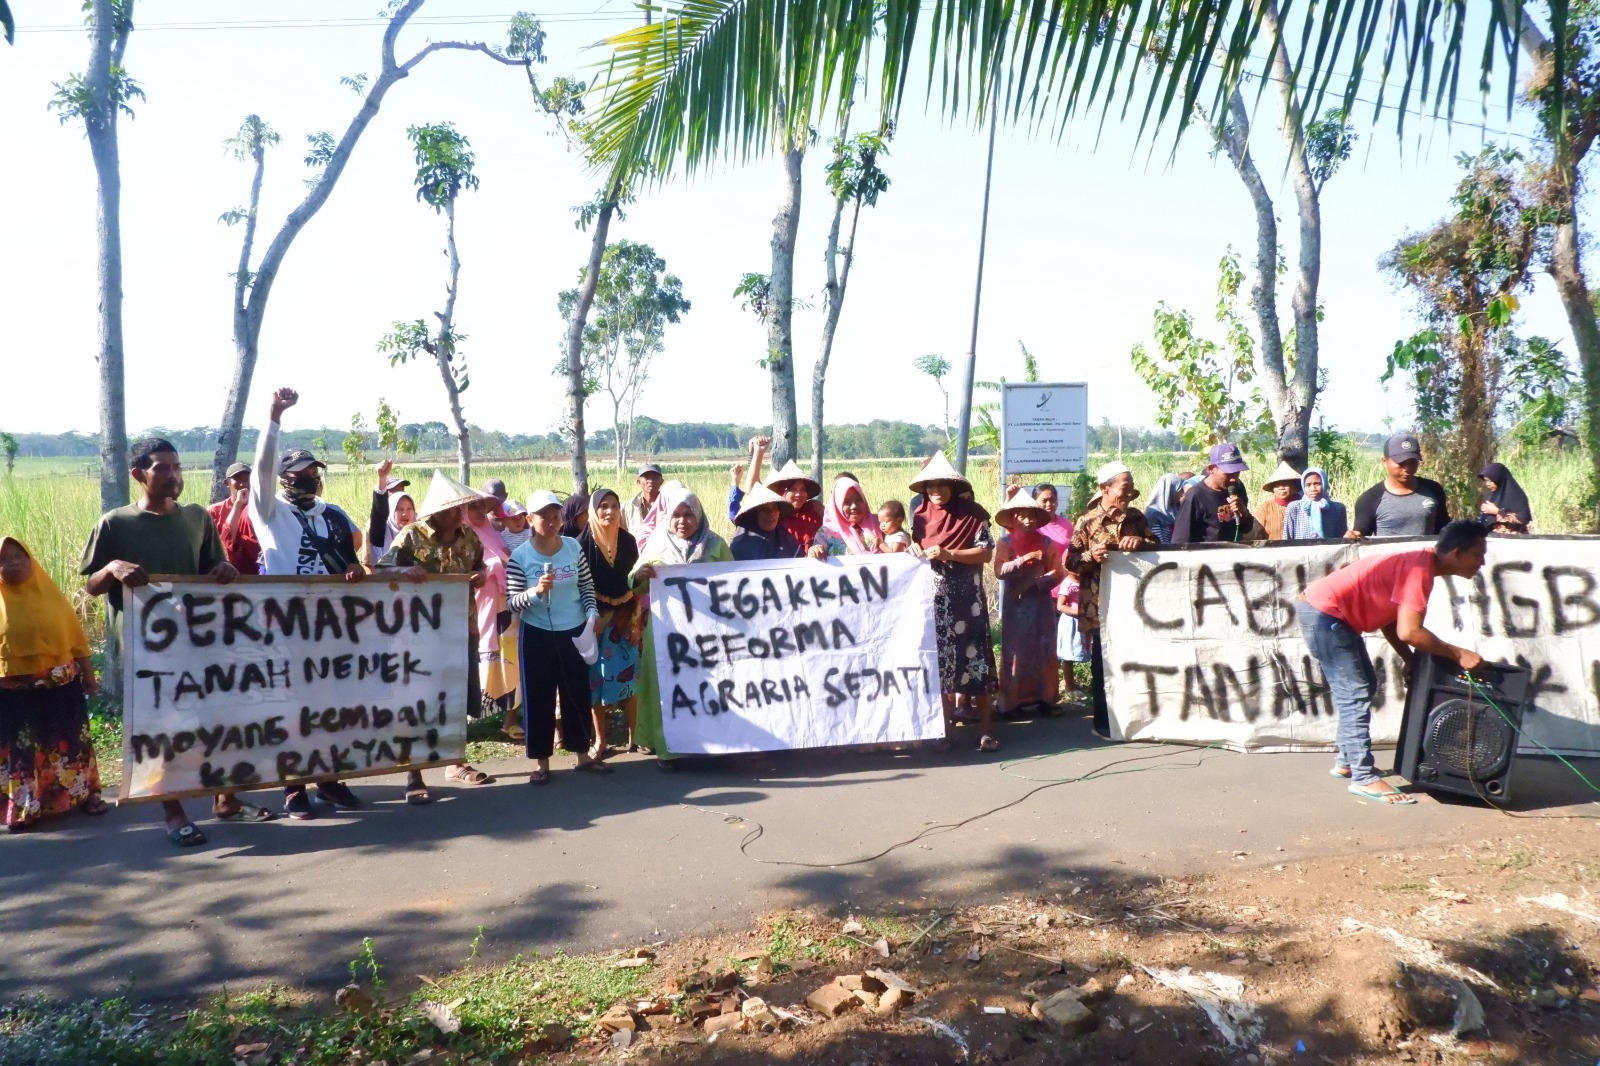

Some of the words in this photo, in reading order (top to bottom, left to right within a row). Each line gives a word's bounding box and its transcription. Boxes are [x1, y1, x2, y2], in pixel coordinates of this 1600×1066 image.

[139, 591, 443, 652] GERMAPUN
[663, 565, 889, 623] TEGAKKAN
[666, 618, 856, 675] REFORMA
[135, 658, 291, 709] TANAH
[303, 650, 432, 685] NENEK
[671, 675, 811, 719] AGRARIA
[822, 666, 931, 708] SEJATI
[276, 727, 440, 781] RAKYAT!
